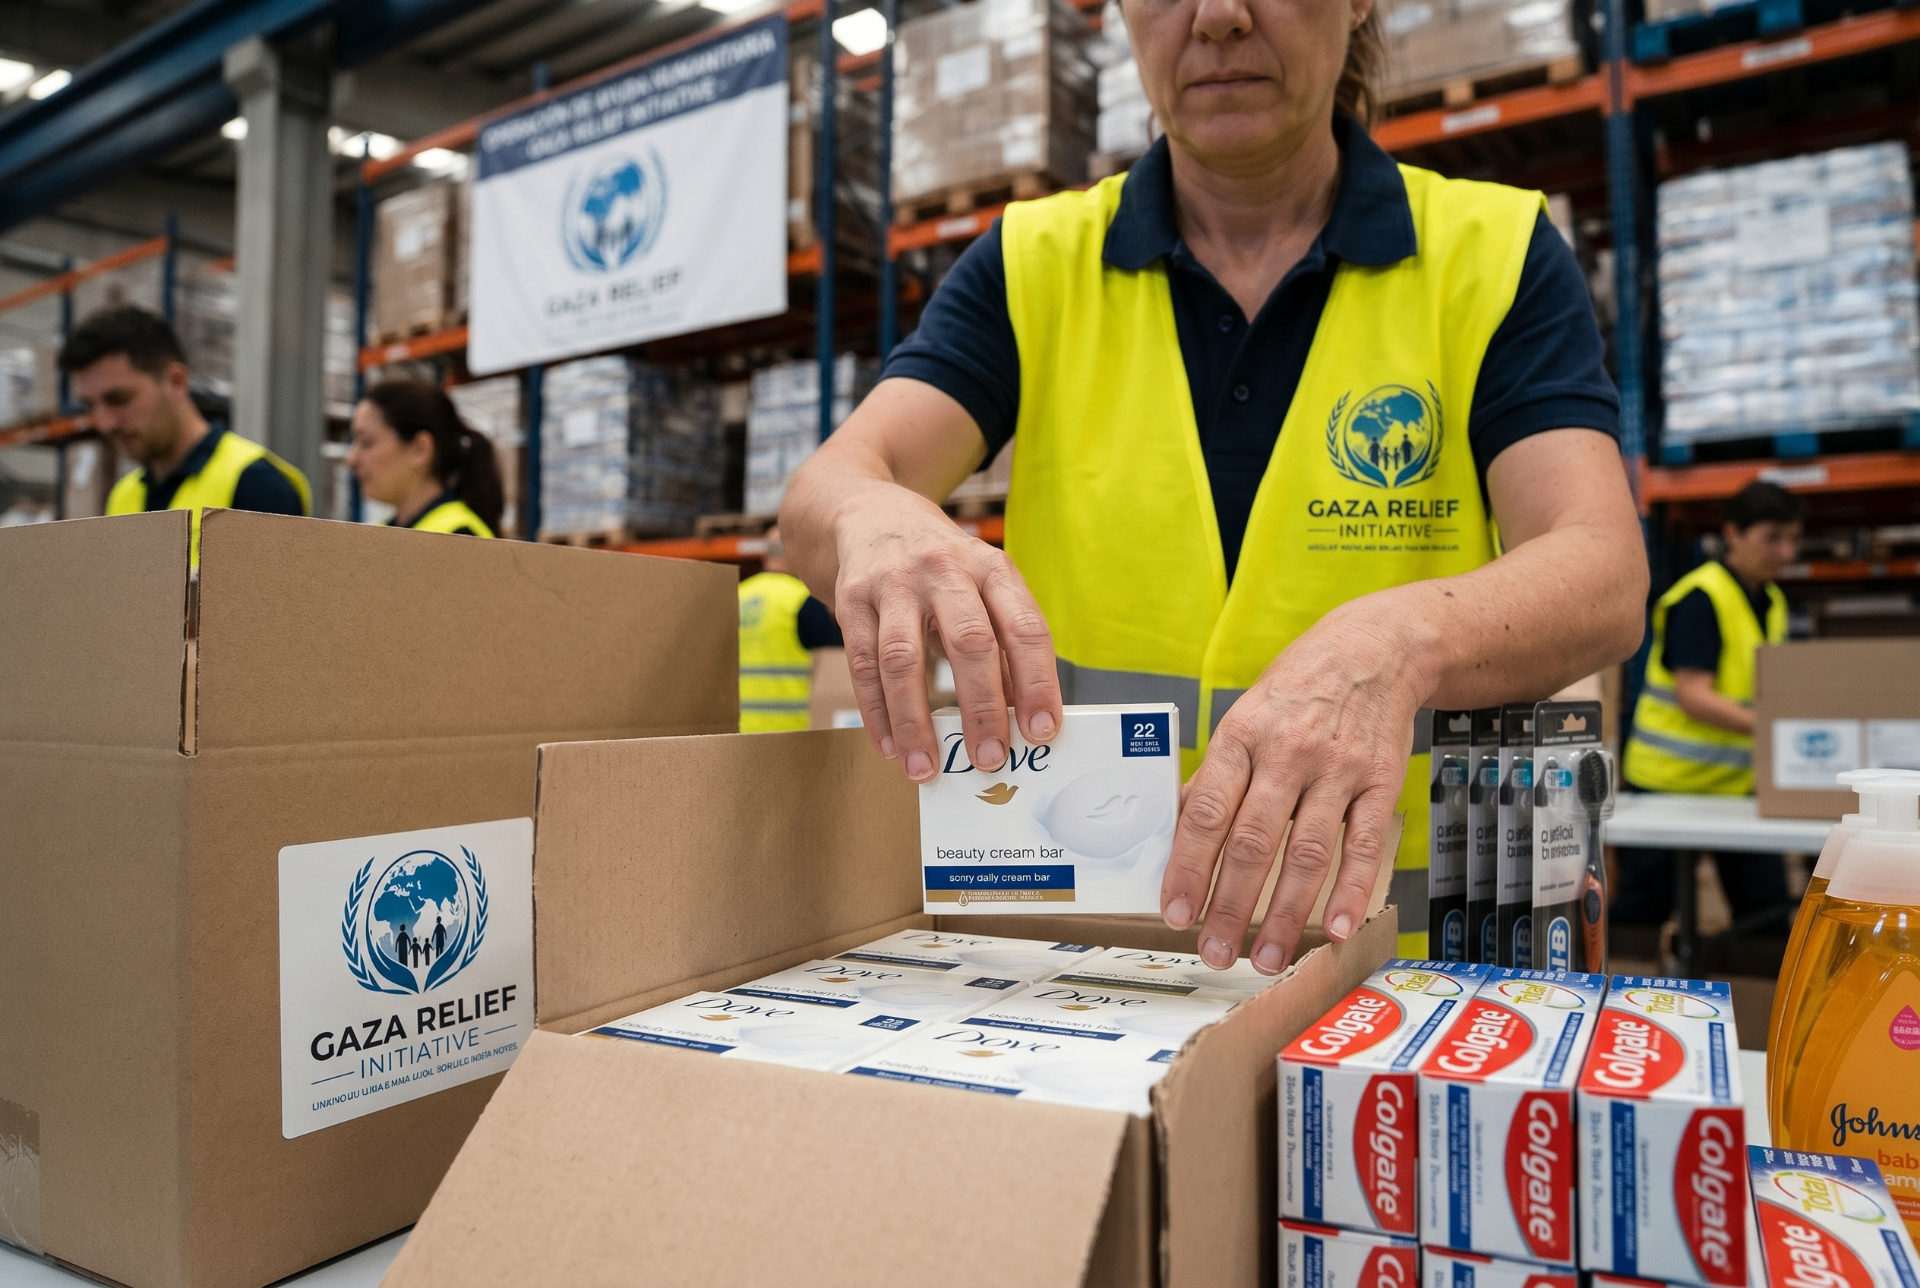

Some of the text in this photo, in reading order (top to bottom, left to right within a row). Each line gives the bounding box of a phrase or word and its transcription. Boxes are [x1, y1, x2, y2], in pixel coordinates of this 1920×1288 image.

[1308, 500, 1459, 518] GAZA RELIEF
[1339, 524, 1432, 538] INITIATIVE
[1133, 723, 1155, 738] 22
[943, 733, 1050, 773] Dve
[937, 845, 1064, 862] beauty cream bar
[1002, 874, 1032, 882] cream
[1034, 873, 1051, 882] bar
[902, 933, 993, 945] Dove
[804, 964, 902, 979] Dove
[684, 997, 795, 1018] Dove
[1033, 989, 1148, 1007] Dove
[310, 984, 516, 1061] GAZA RELIEF
[1300, 997, 1388, 1056] Colgate
[361, 1027, 480, 1079] INITIATIVE
[932, 1028, 1061, 1053] Dove
[1437, 1009, 1512, 1074] Colgate
[1594, 1020, 1661, 1088] Colgate
[1370, 1080, 1404, 1216] Colgate
[1520, 1099, 1558, 1242] Colgate
[1691, 1115, 1734, 1267] Colgate
